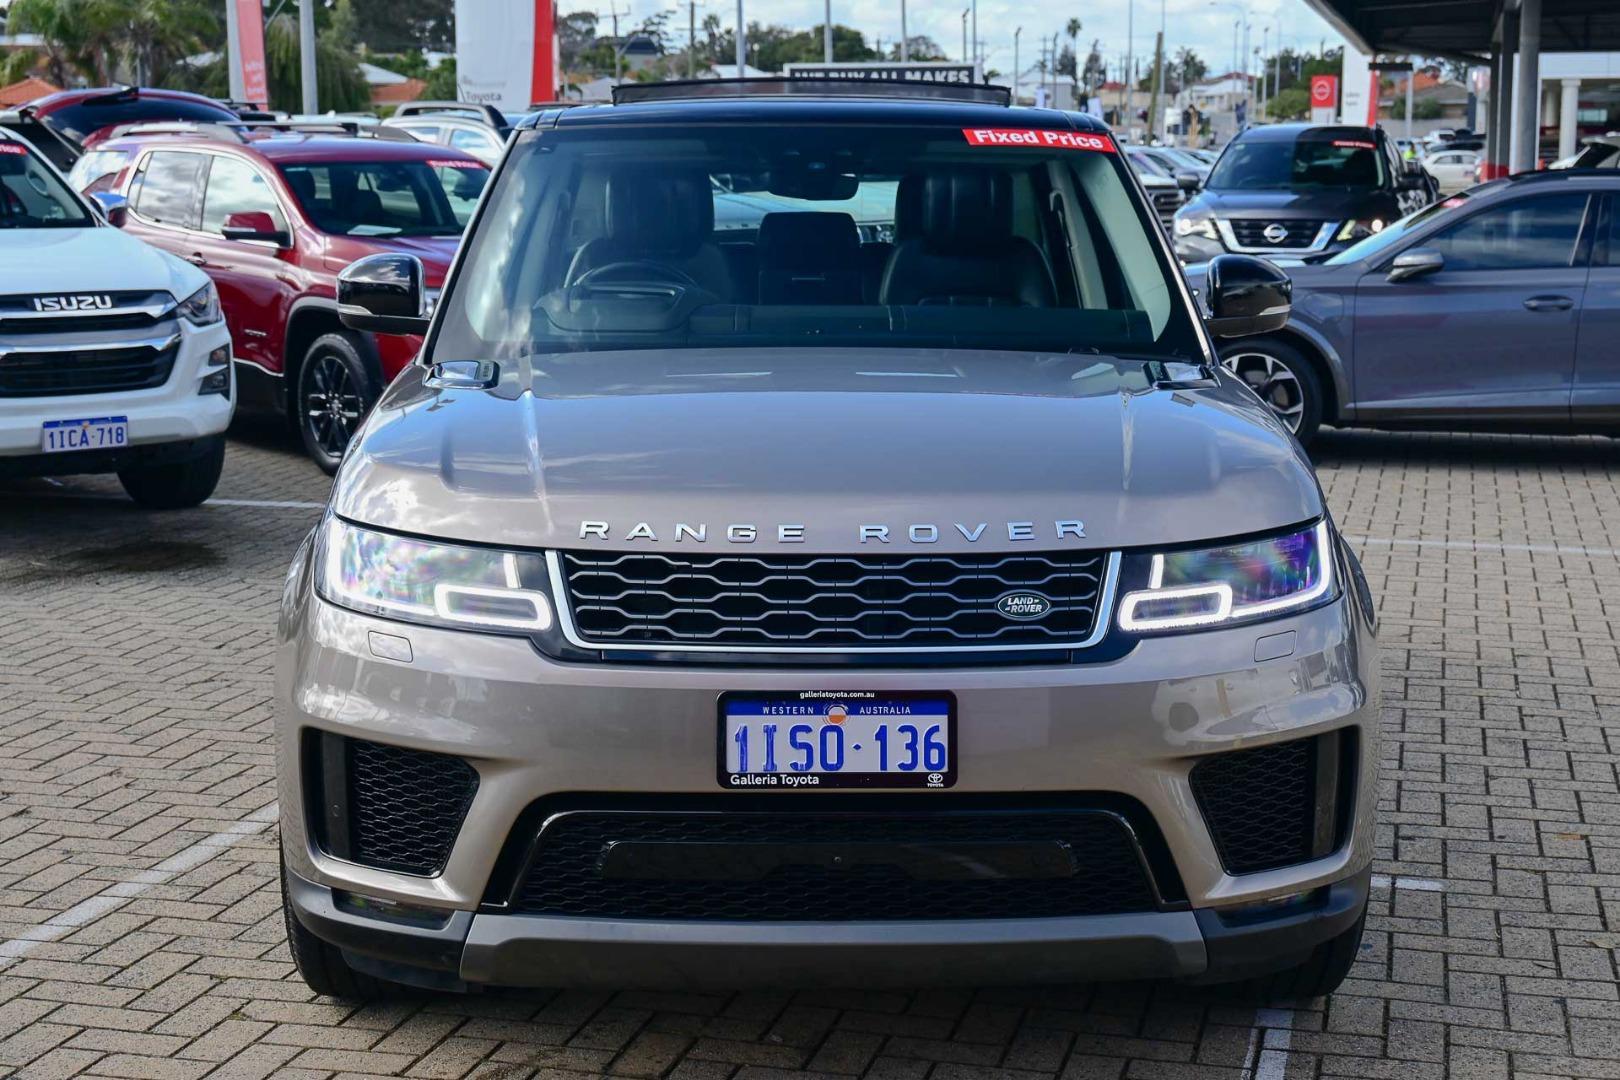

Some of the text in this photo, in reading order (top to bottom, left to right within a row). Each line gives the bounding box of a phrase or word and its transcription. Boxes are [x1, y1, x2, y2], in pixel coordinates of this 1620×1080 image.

[904, 70, 970, 83] MAKES
[973, 129, 1104, 149] Fixed Price
[34, 295, 113, 312] ISUZU
[578, 519, 1087, 544] RANGE ROVER
[800, 690, 875, 699] galleriatoyota.com.au
[762, 706, 911, 714] WESTERN AUSTRALIA
[730, 774, 820, 787] Galleria Toyota
